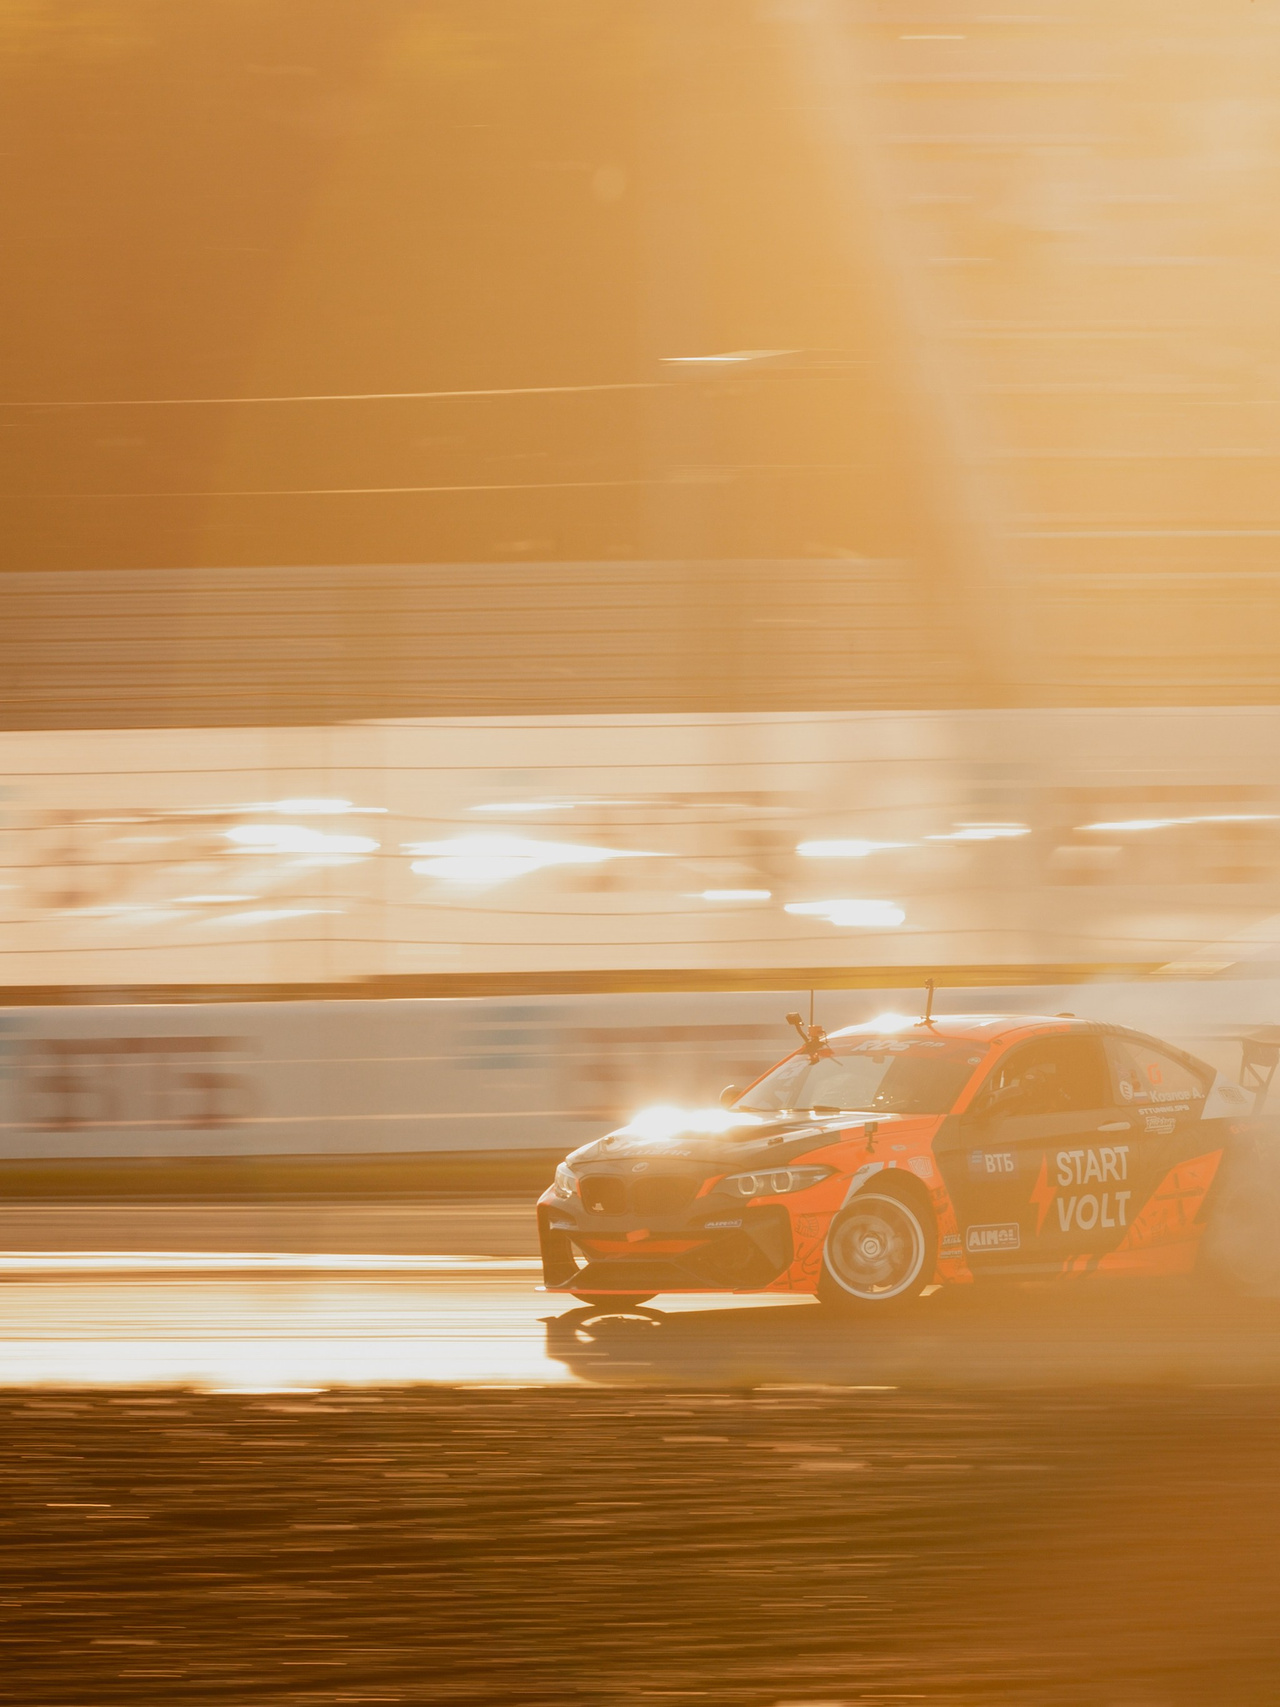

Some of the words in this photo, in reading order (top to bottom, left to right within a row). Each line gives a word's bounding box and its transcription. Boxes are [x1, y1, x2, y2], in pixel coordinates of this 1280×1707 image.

[1149, 1090, 1191, 1103] Козлов
[984, 1152, 1014, 1173] ВТБ
[1056, 1146, 1130, 1187] START
[1056, 1190, 1132, 1232] VOLT
[969, 1228, 1018, 1247] AIMOL
